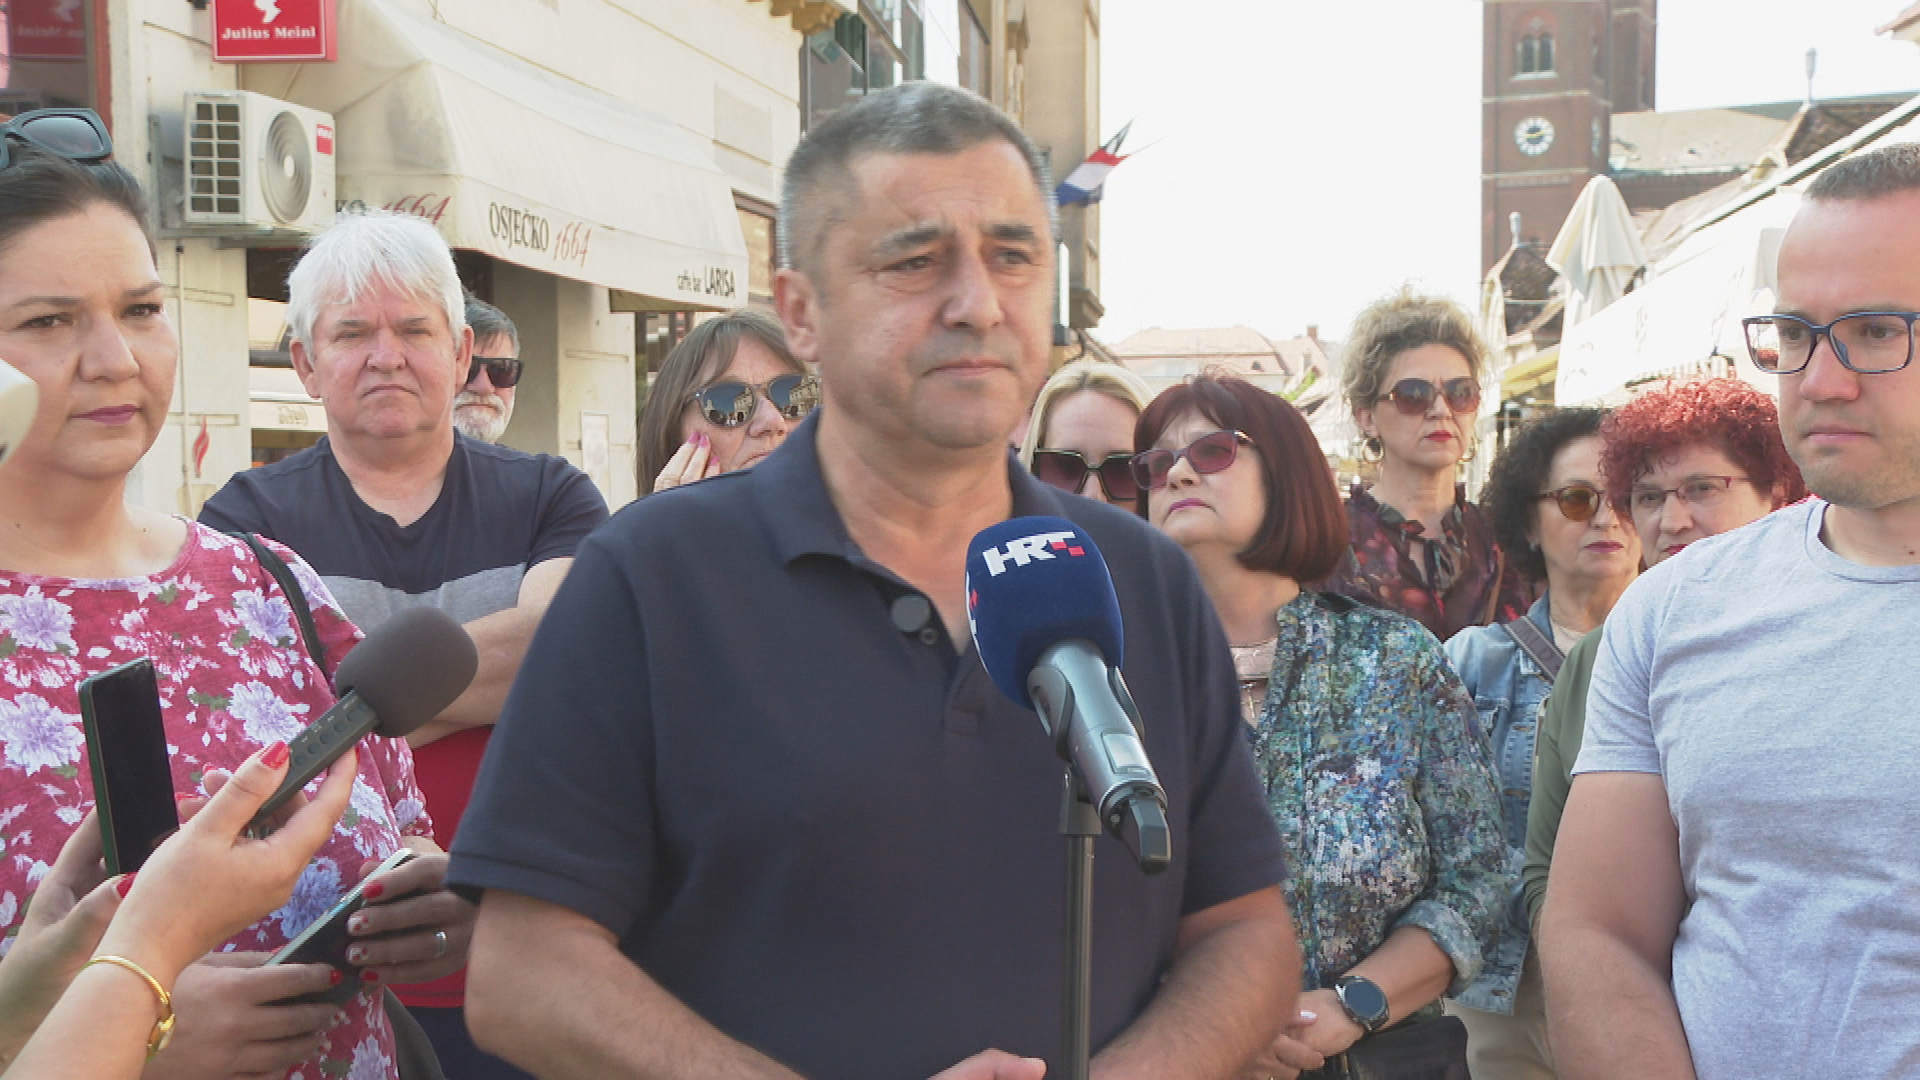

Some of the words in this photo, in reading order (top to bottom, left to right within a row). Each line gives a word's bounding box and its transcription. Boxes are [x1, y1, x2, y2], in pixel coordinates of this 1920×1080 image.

[222, 27, 271, 39] Julius
[274, 26, 316, 38] Meinl
[489, 202, 549, 251] OSJEČKO
[553, 222, 592, 268] 1664
[704, 265, 736, 298] LARISA
[982, 531, 1085, 576] HRT
